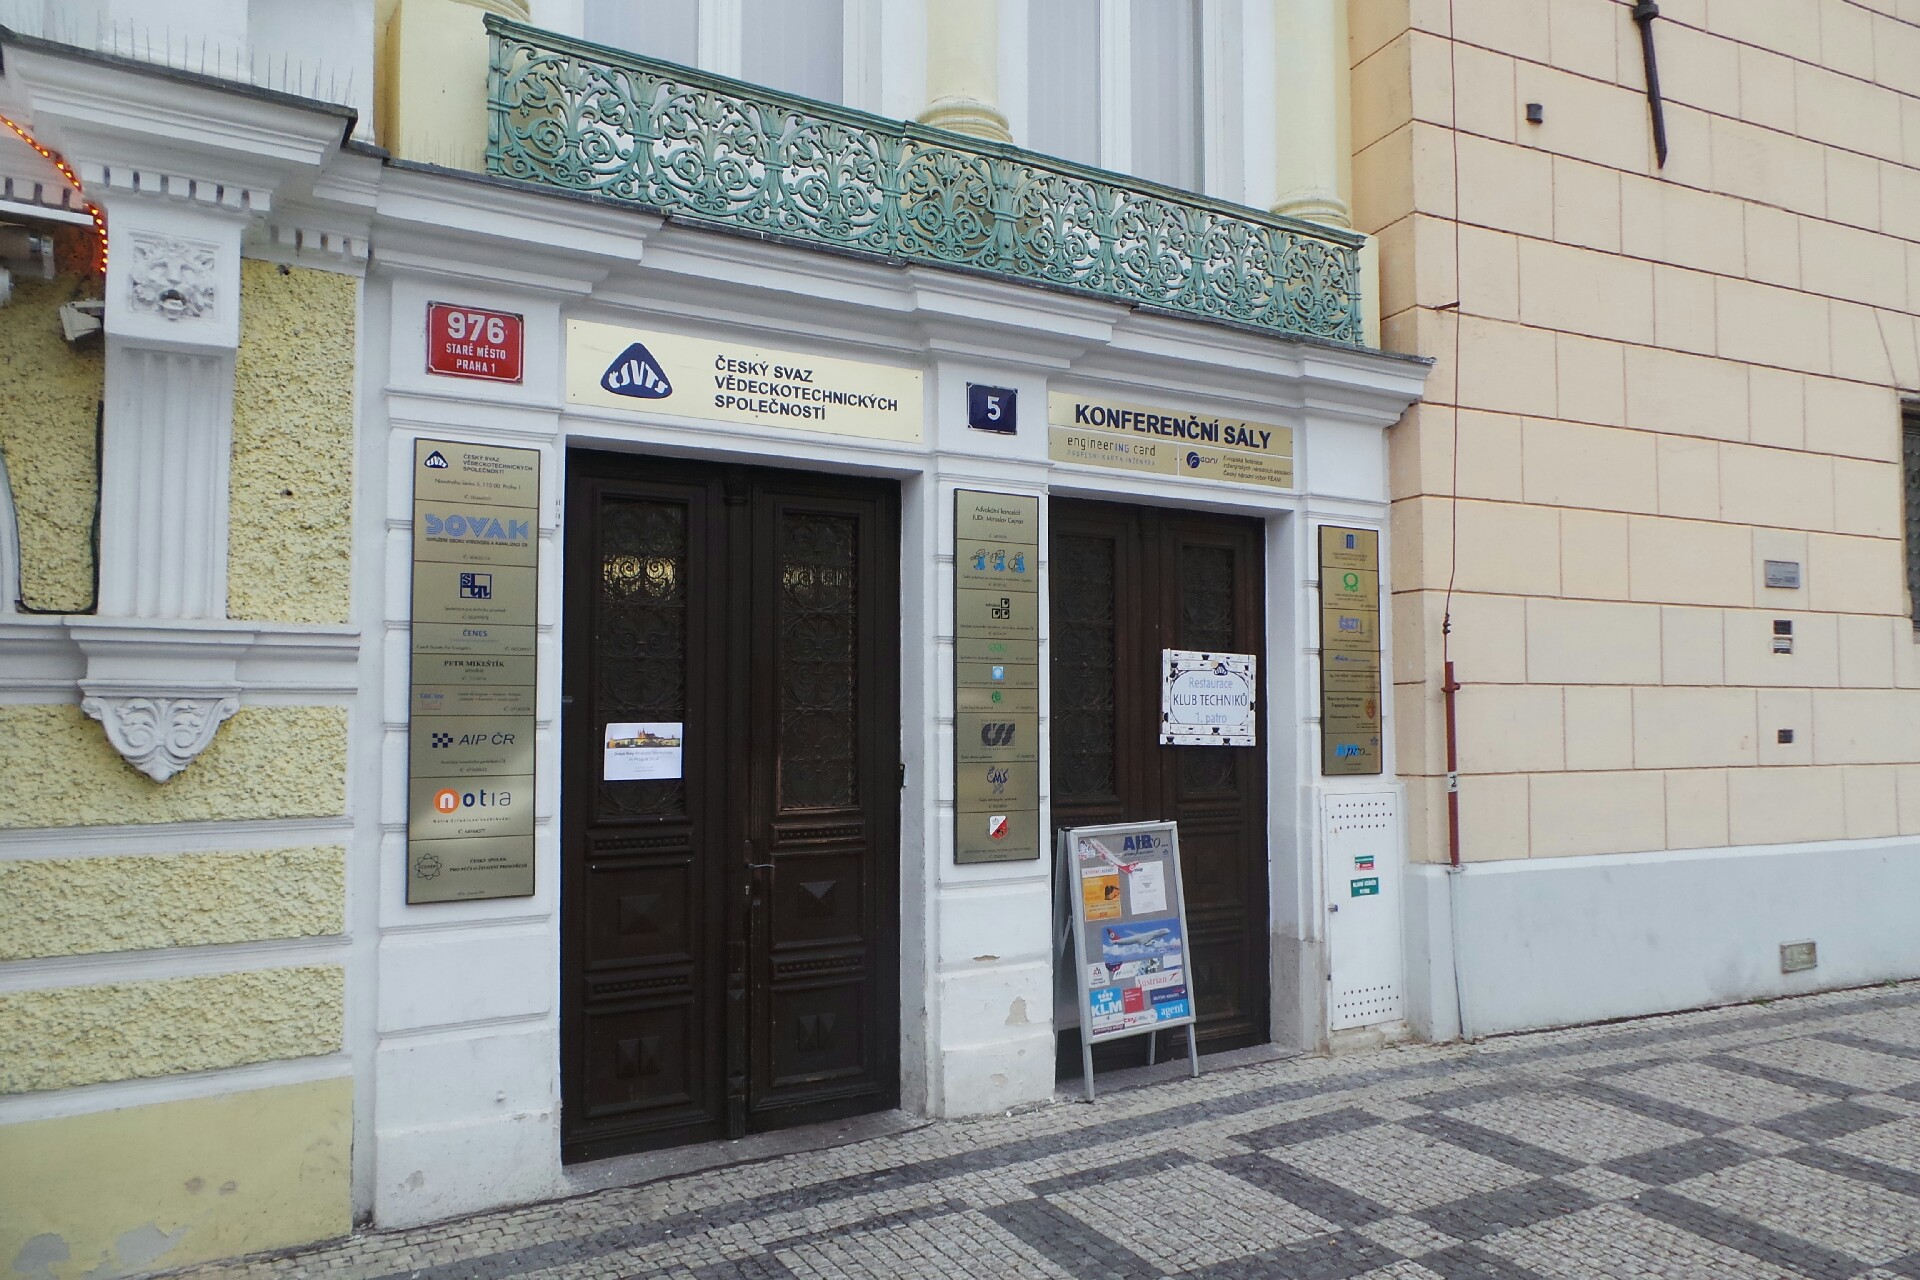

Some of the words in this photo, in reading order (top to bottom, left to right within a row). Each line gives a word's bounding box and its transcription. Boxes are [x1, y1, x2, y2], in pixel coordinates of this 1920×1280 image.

[448, 311, 504, 344] 976
[446, 343, 473, 356] STARÉ
[477, 345, 506, 360] MĚSTO
[456, 359, 488, 373] PRAHA
[491, 362, 496, 374] 1
[714, 354, 769, 377] ČESKÝ
[773, 365, 814, 383] SVAZ
[714, 374, 898, 412] VĚDECKOTECHNICKÝCH
[714, 394, 826, 420] SPOLEČNOSTÍ
[986, 396, 1001, 421] 5
[1075, 403, 1219, 442] KONFERENČNÍ
[1223, 423, 1272, 449] SÁLY
[1067, 436, 1130, 454] engineerING
[1133, 445, 1156, 457] card
[425, 513, 529, 540] SOVAK
[462, 628, 488, 637] ČENES
[1188, 677, 1233, 689] Restaurace
[1173, 693, 1197, 706] KLUB
[1199, 692, 1248, 707] TECHNIKŮ
[1195, 712, 1203, 723] 1.
[1205, 713, 1228, 725] patro
[458, 734, 488, 746] AIP
[491, 731, 516, 746] ČR
[439, 788, 511, 809] notia
[1091, 999, 1123, 1017] KLM
[1161, 1003, 1184, 1018] agent
